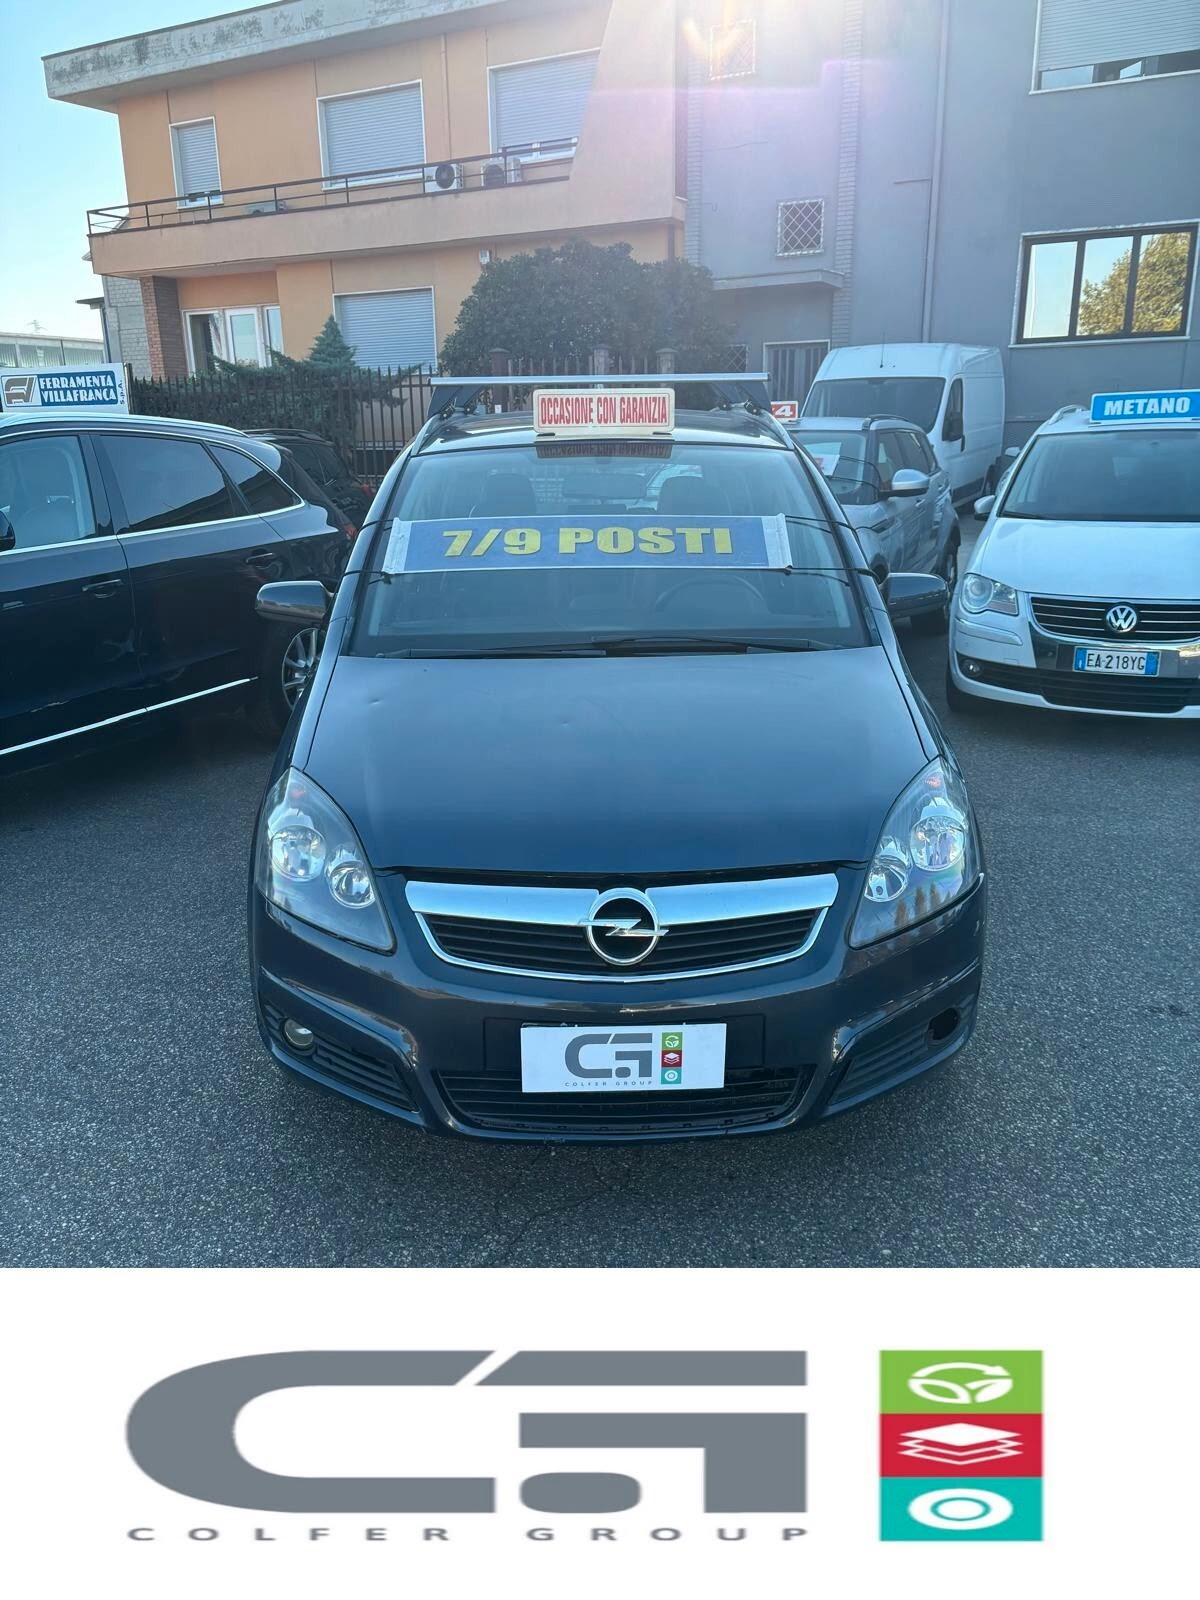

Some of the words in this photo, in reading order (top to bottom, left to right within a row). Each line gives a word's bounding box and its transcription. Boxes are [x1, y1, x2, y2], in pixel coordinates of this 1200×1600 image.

[40, 375, 114, 389] FERRAMENTA
[41, 388, 117, 403] VILLAFRANCA
[540, 397, 593, 424] OCCASIONE
[597, 397, 617, 424] CON
[620, 396, 667, 424] GARANZIA
[1103, 397, 1191, 416] METANO
[442, 528, 541, 557] 7/9
[559, 527, 733, 554] POSTI
